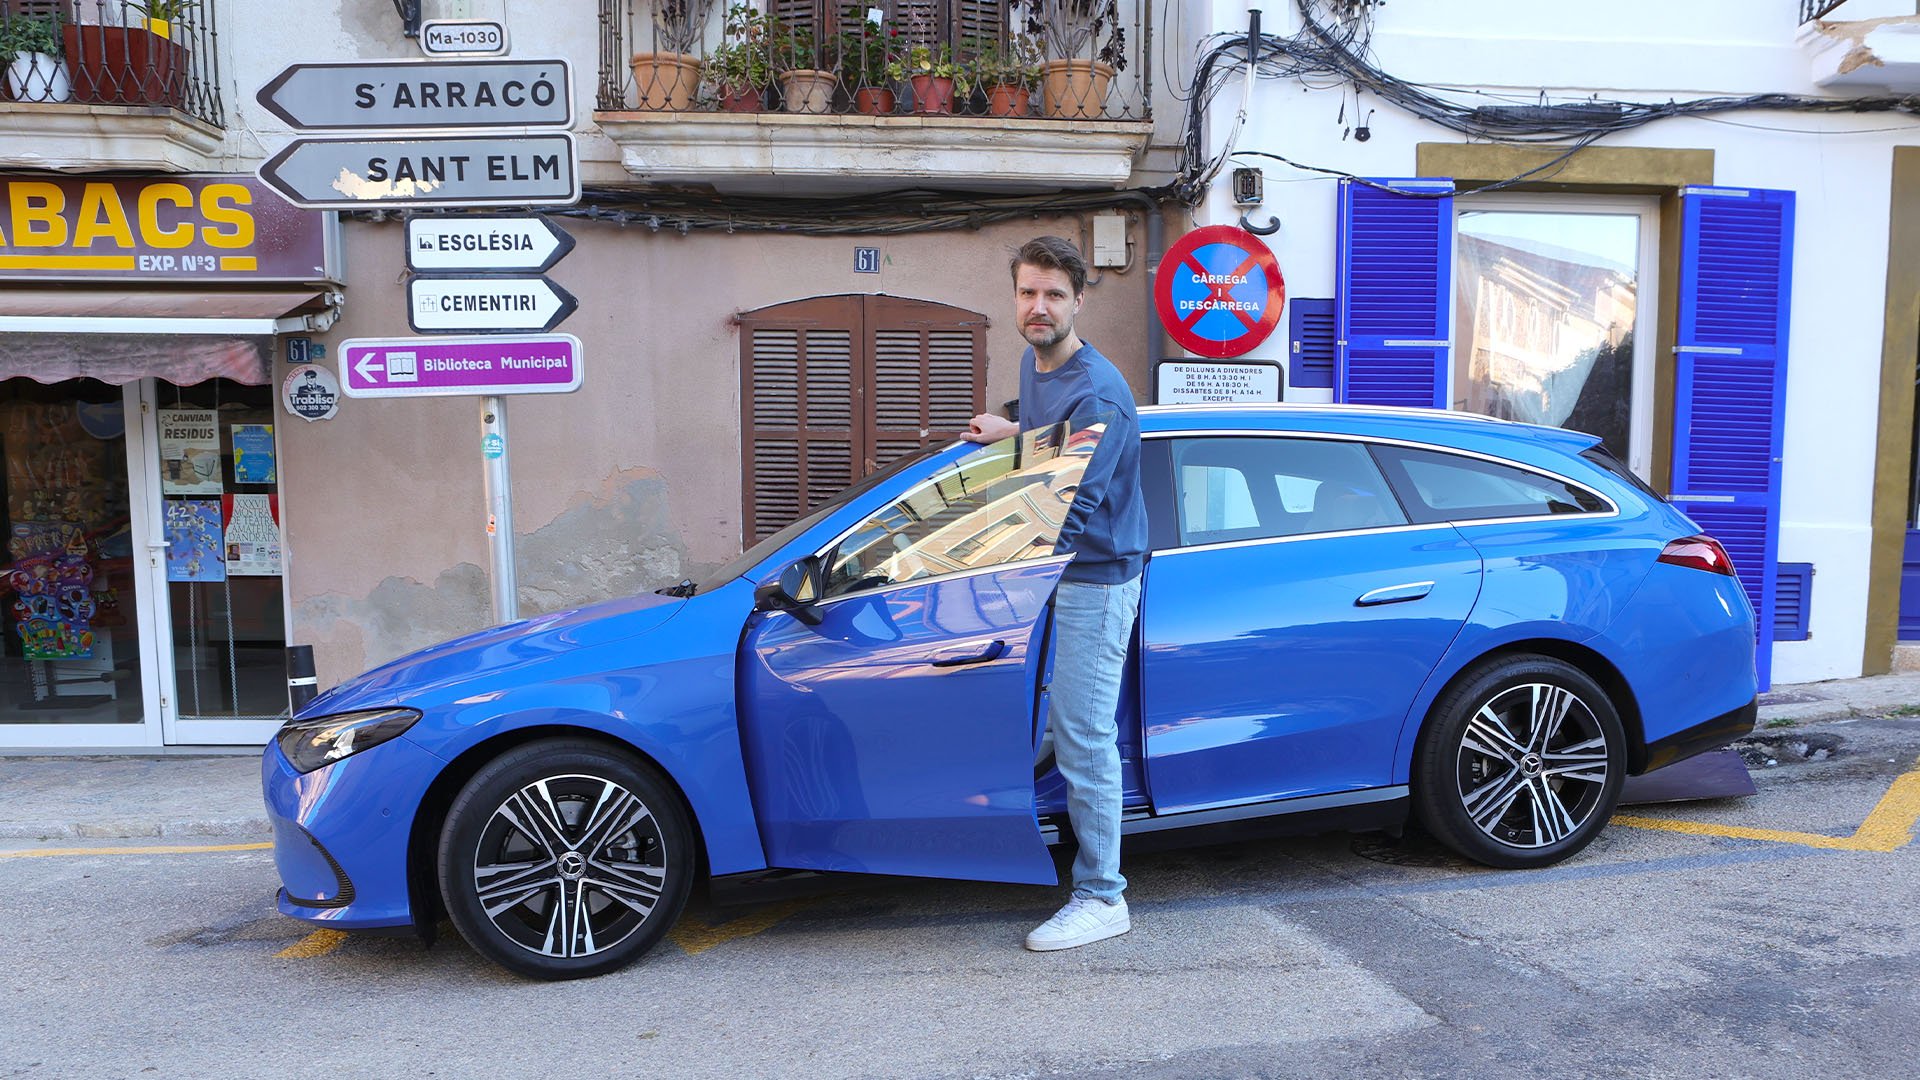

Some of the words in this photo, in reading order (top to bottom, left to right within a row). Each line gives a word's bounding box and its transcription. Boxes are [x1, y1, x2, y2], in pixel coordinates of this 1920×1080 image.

[430, 31, 497, 45] Ma-1030
[367, 156, 470, 182] SANT
[487, 154, 560, 181] ELM
[0, 181, 256, 249] BACS
[438, 230, 534, 251] ESGLÉSIA
[138, 255, 178, 272] EXP.
[182, 255, 216, 272] Nº3
[858, 249, 875, 271] 61
[1191, 273, 1248, 285] CÀRREGA
[1217, 288, 1222, 297] I
[441, 294, 536, 312] CEMENTIRI
[1180, 299, 1260, 311] DESCÀRREGA
[290, 339, 308, 361] 61
[423, 358, 493, 372] Biblioteca
[501, 355, 568, 371] Municipal
[290, 394, 334, 405] Trablisa
[172, 414, 212, 422] CANVIAM
[164, 428, 215, 439] RESIDUS
[167, 506, 190, 520] 42
[234, 508, 270, 517] MOSTRA
[230, 516, 241, 525] DE
[245, 517, 275, 526] TEATRE
[231, 525, 274, 534] AMATEUR
